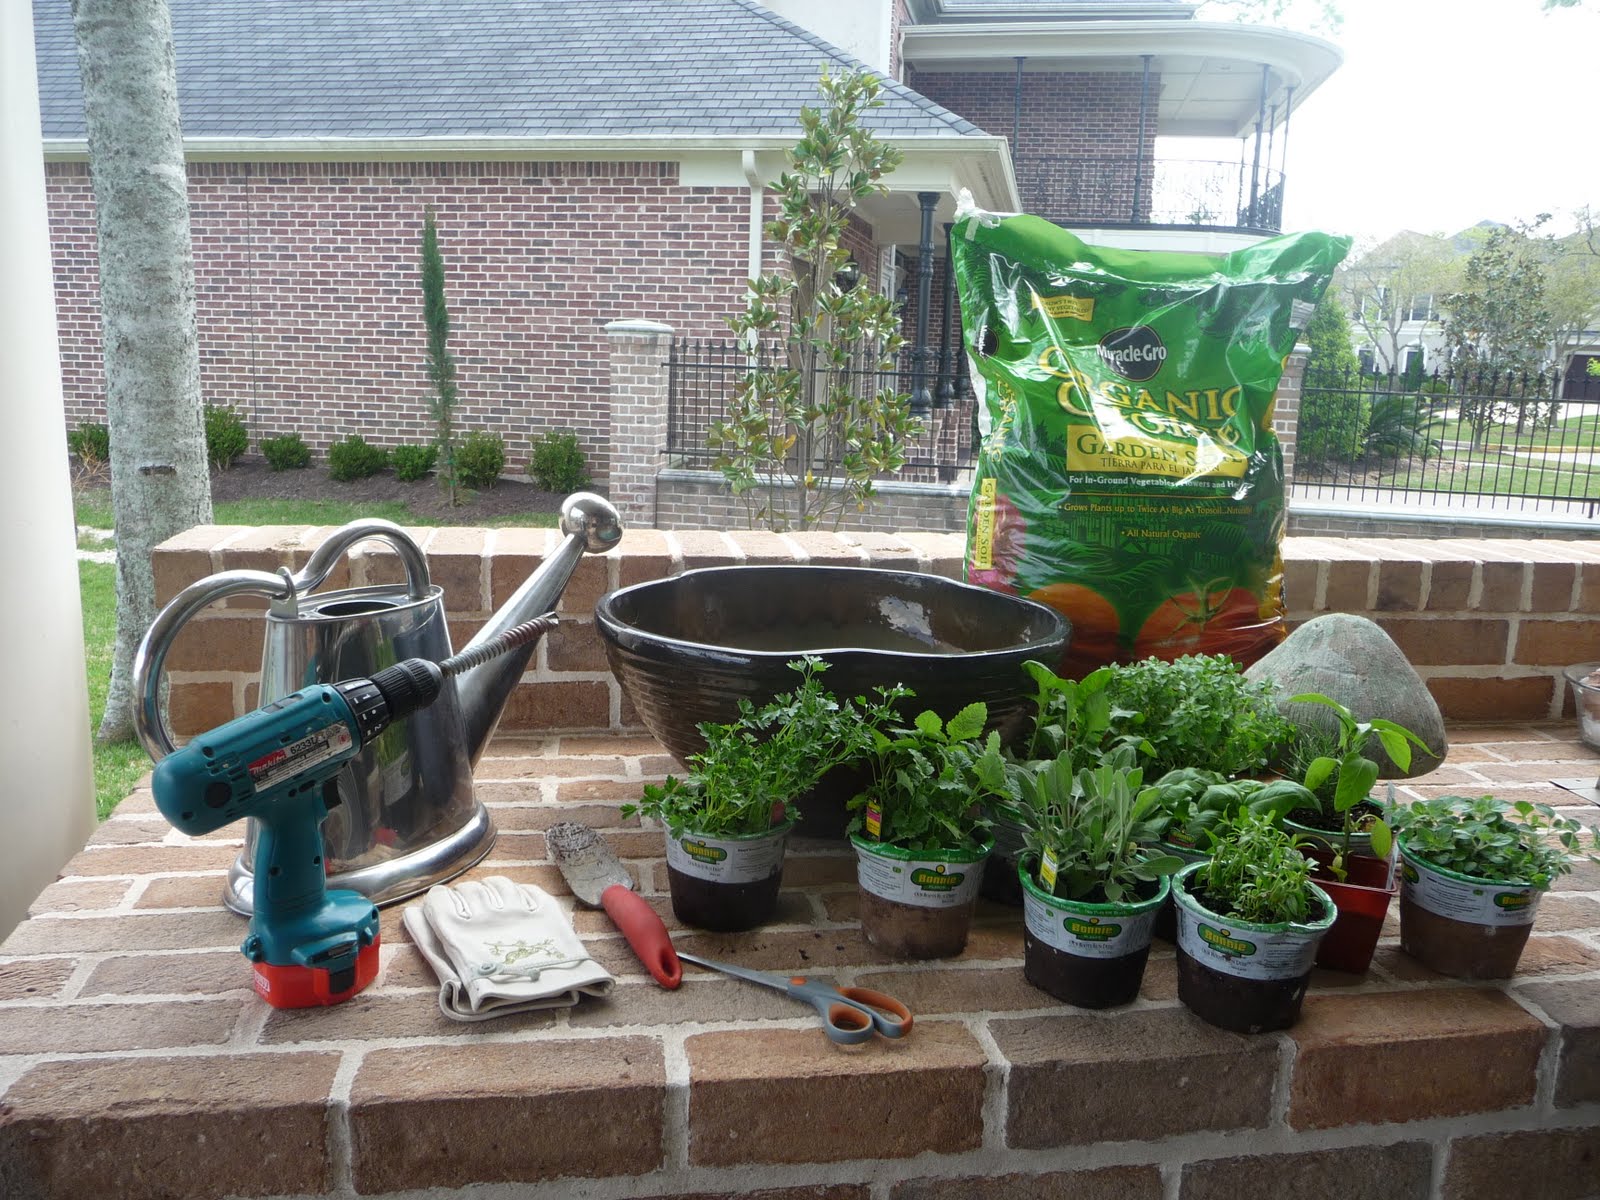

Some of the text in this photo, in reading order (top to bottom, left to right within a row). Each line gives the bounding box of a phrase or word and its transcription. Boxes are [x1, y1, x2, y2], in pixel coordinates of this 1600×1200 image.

[1097, 344, 1167, 363] Miracle-Gro
[1076, 433, 1178, 464] GARDEN
[1102, 457, 1138, 469] TIERRA
[1141, 461, 1165, 472] PARA
[1169, 465, 1180, 473] EL
[1069, 475, 1083, 484] For
[1085, 475, 1128, 485] In-Ground
[1212, 480, 1225, 488] and
[1064, 503, 1088, 511] Grows
[1090, 503, 1112, 512] Plants
[1115, 505, 1124, 513] up
[1138, 504, 1157, 513] Twice
[1160, 505, 1169, 513] As
[1185, 506, 1194, 514] As
[1127, 529, 1201, 539] All Natural Organic
[1071, 922, 1113, 936] Bonnie
